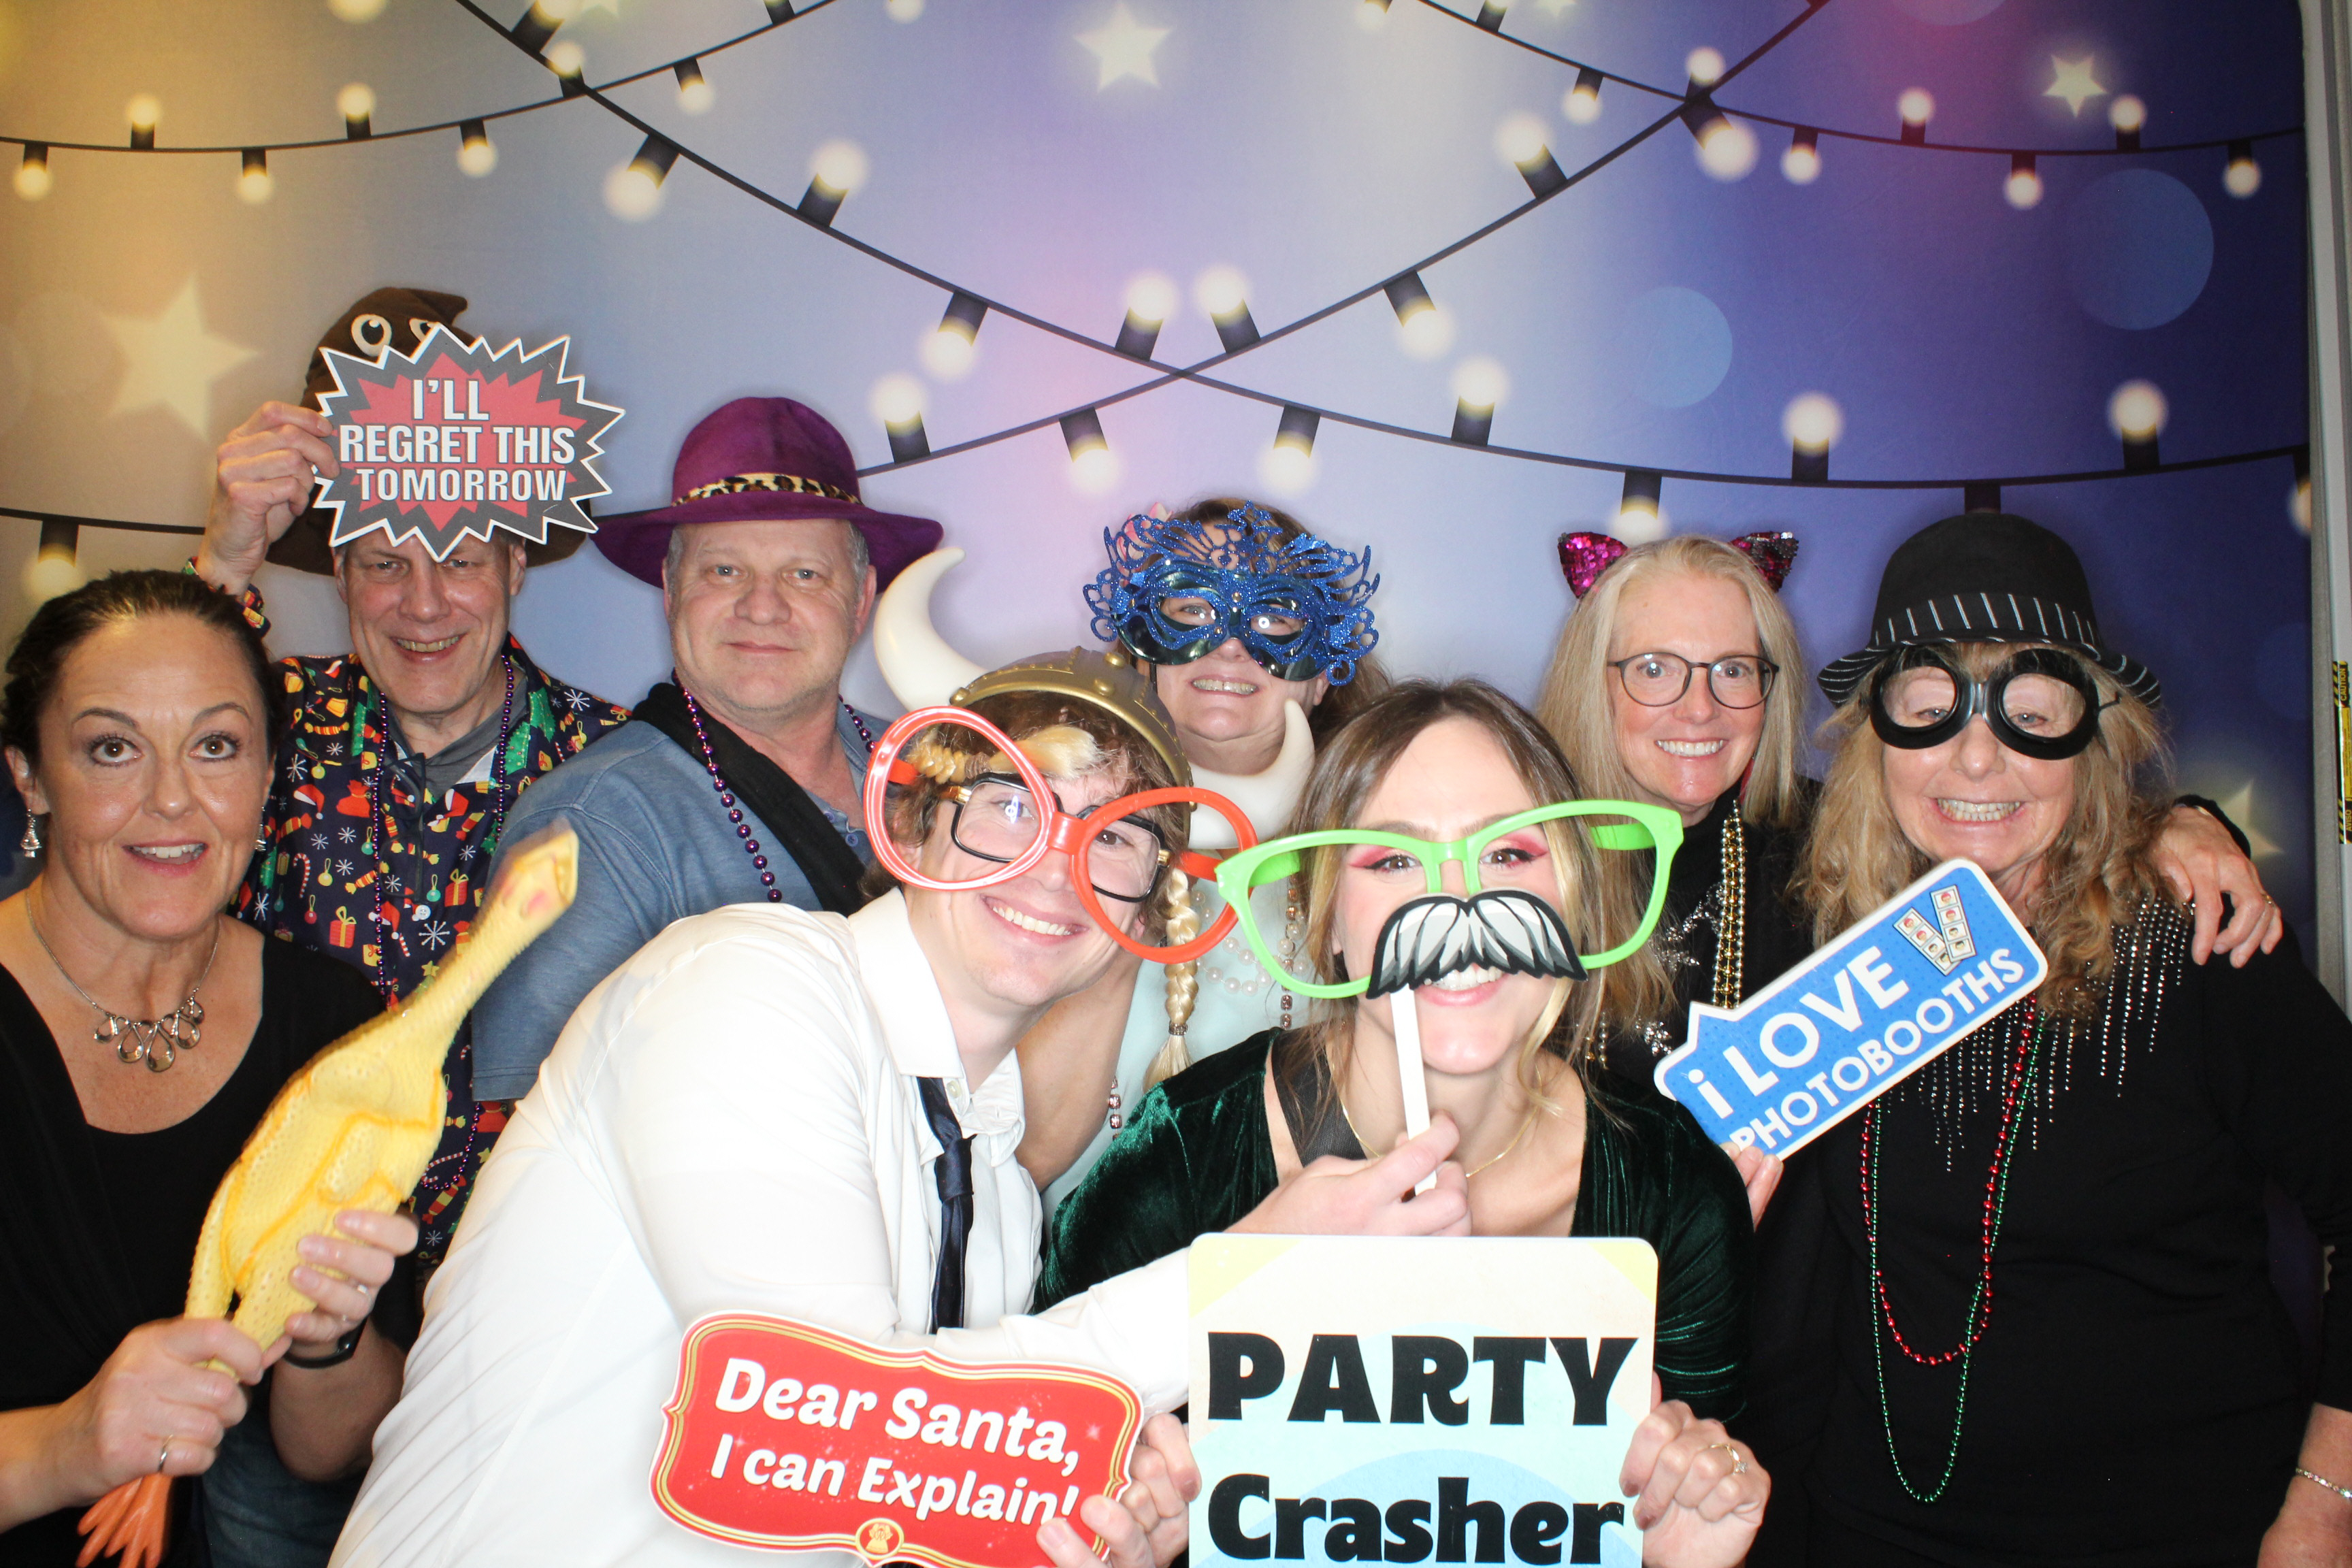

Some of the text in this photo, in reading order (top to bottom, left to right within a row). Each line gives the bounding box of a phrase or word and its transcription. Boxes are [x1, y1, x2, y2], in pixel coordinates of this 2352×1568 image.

[413, 378, 489, 421] I'LL
[340, 424, 576, 465] REGRET THIS
[356, 468, 567, 502] TOMORROW
[2339, 668, 2347, 701] CAUTION
[1688, 945, 1910, 1120] i LOVE
[1729, 948, 2024, 1152] PHOTOBOOTHS
[715, 1357, 1080, 1477] Dear Santa,
[1207, 1330, 1640, 1427] PARTY
[710, 1433, 734, 1479] I
[742, 1448, 847, 1497] can
[1207, 1472, 1625, 1566] Crasher
